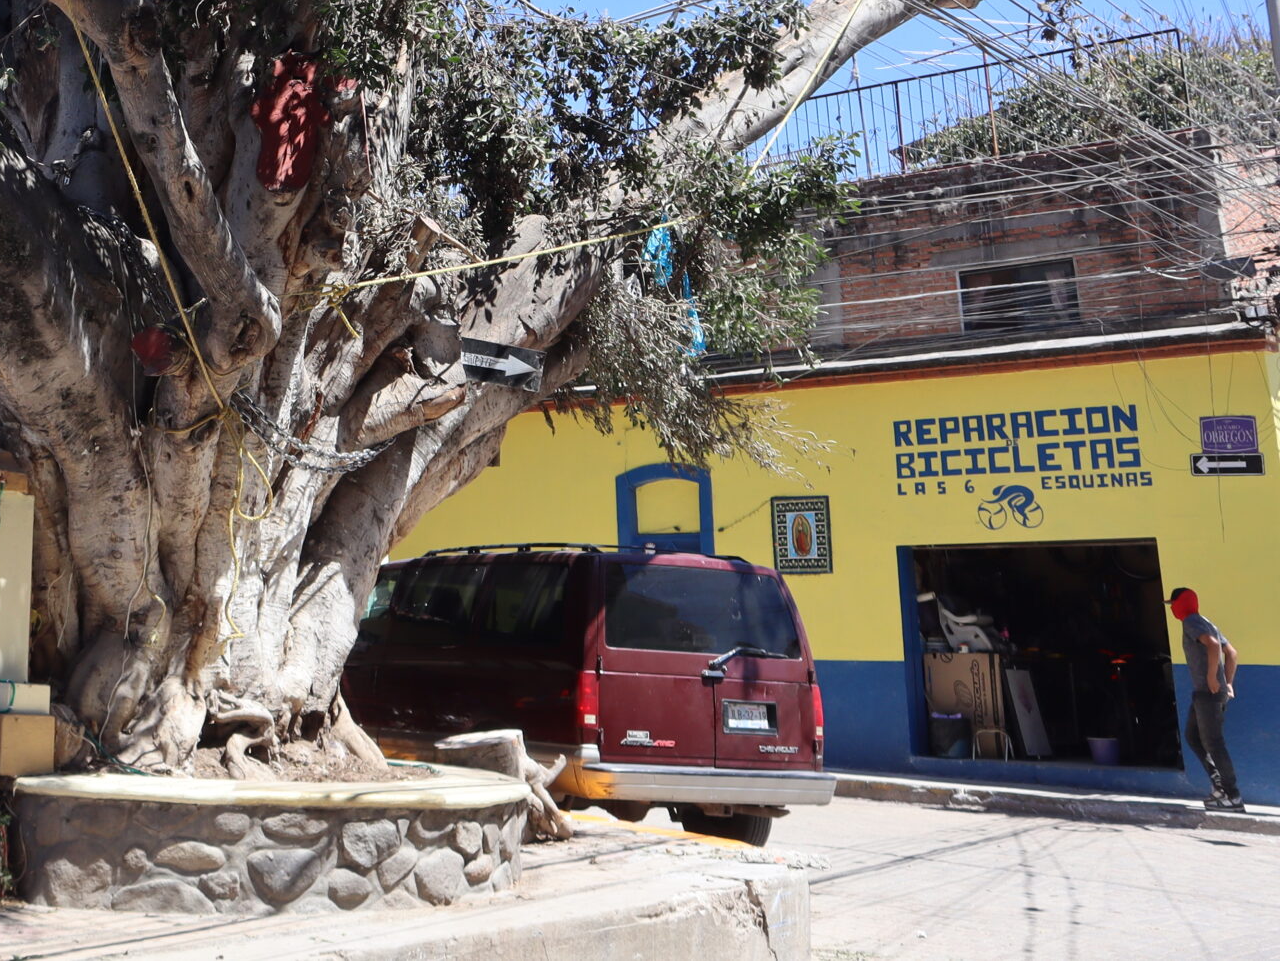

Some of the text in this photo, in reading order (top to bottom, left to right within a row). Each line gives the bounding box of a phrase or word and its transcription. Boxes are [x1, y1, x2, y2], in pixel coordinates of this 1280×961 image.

[893, 404, 1139, 447] REPARACION
[1006, 439, 1018, 447] DE
[895, 436, 1142, 479] BICICLETAS
[964, 480, 975, 494] 6
[1041, 471, 1154, 491] ESQUINAS
[759, 745, 799, 753] CHEVROLET
